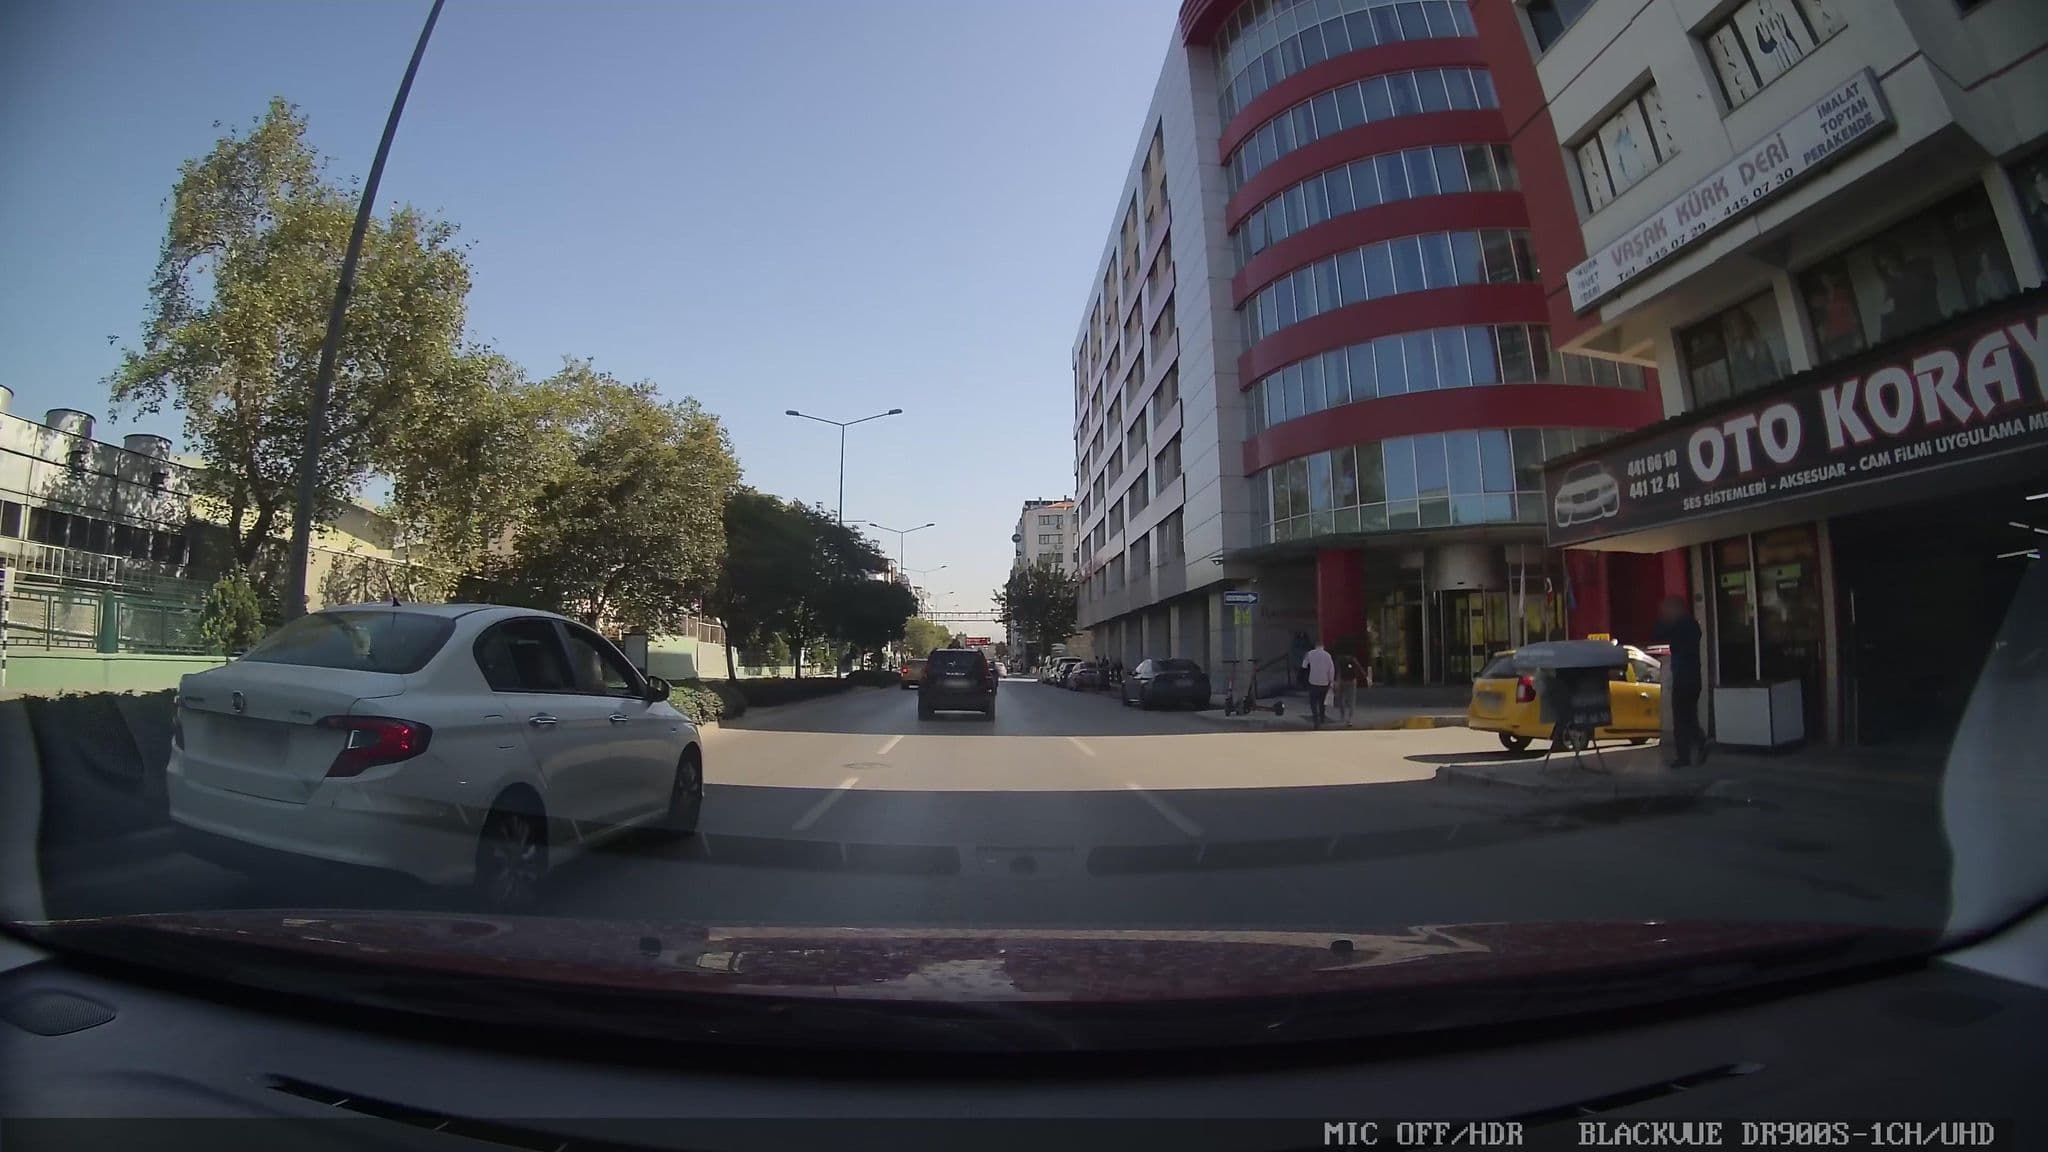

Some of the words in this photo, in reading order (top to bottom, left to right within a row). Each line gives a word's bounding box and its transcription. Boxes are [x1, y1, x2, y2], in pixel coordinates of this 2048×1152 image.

[1816, 82, 1861, 120] İMALAT
[1820, 97, 1870, 136] TOPTAN
[1803, 111, 1876, 167] PERAKENDE
[1610, 216, 1668, 267] VAŞAK
[1675, 177, 1729, 226] KÜRK
[1738, 132, 1790, 187] DERİ
[1723, 195, 1749, 217] 445
[1753, 183, 1770, 198] 07
[1776, 167, 1794, 184] 30
[1683, 493, 1702, 512] SES
[1703, 479, 1767, 507] SİSTEMLERİ
[1779, 463, 1846, 492] AKSESUAR
[1859, 450, 1891, 472] CAM
[1895, 439, 1932, 466] FİLMİ
[1936, 420, 2026, 454] UYGULAMA
[1688, 403, 1801, 482] OTO
[1629, 479, 1648, 499] 441
[1650, 475, 1664, 494] 12
[1666, 471, 1680, 491] 41
